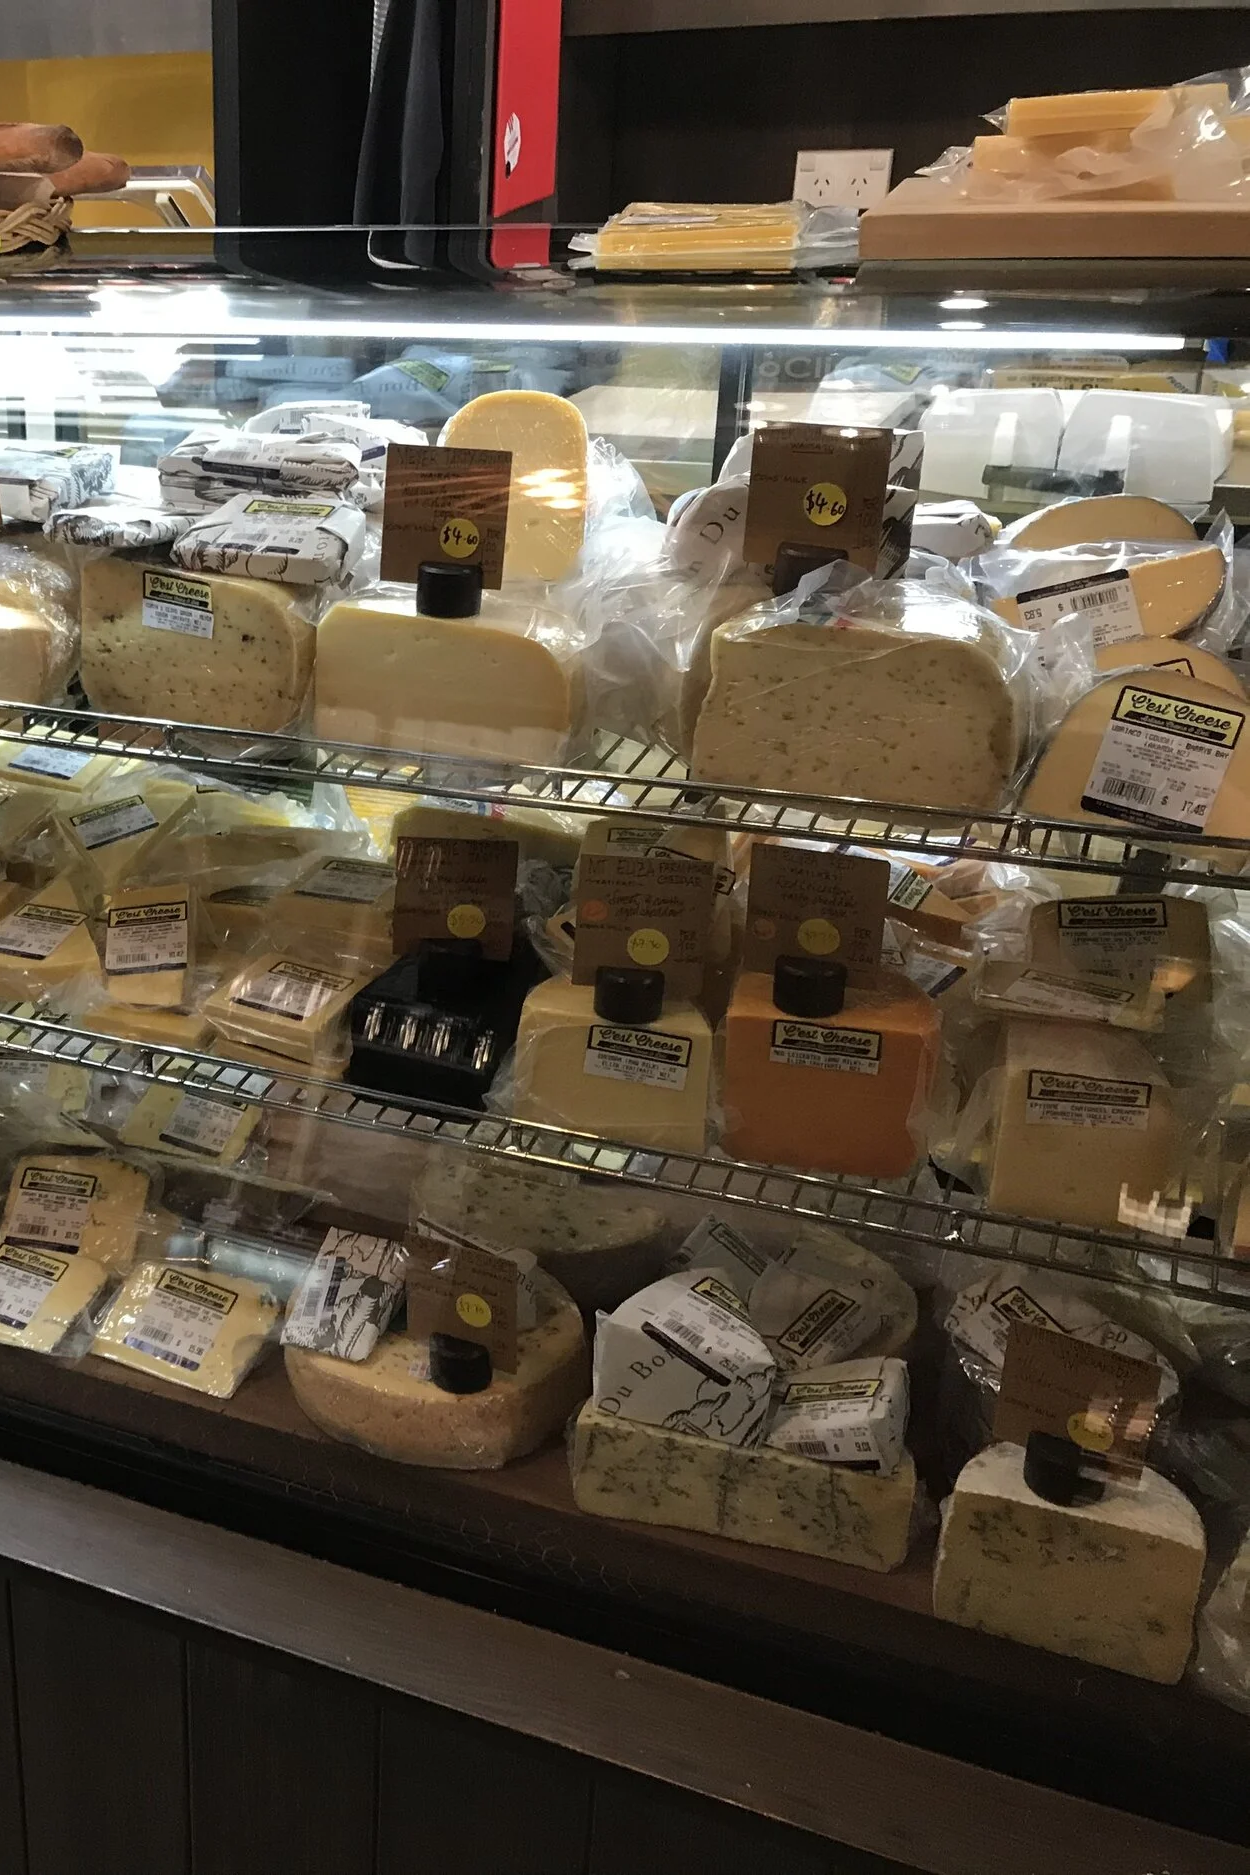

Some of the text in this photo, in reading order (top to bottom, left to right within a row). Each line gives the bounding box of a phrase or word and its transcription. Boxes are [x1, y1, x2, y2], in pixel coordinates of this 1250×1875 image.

[806, 490, 846, 515] $4.60
[443, 526, 478, 545] $4.60
[700, 507, 740, 545] Du
[150, 577, 174, 591] C'est
[176, 582, 210, 599] Cheese
[1024, 608, 1043, 620] 5.83
[1132, 694, 1232, 731] C'est Cheese
[1215, 750, 1229, 760] BAY
[1161, 796, 1168, 806] $
[1182, 800, 1207, 816] 17.48
[116, 906, 181, 919] C'est Cheese
[1068, 905, 1158, 917] C'est Cheese
[600, 1029, 683, 1053] C'est Cheese
[783, 1025, 872, 1046] C'est Cheese
[1040, 1076, 1141, 1095] C'est Cheese
[31, 1172, 90, 1187] C'est Cheese
[5, 1247, 60, 1271] C'est Cheese
[169, 1274, 229, 1302] C'est Cheese
[597, 1349, 675, 1417] Du Bo
